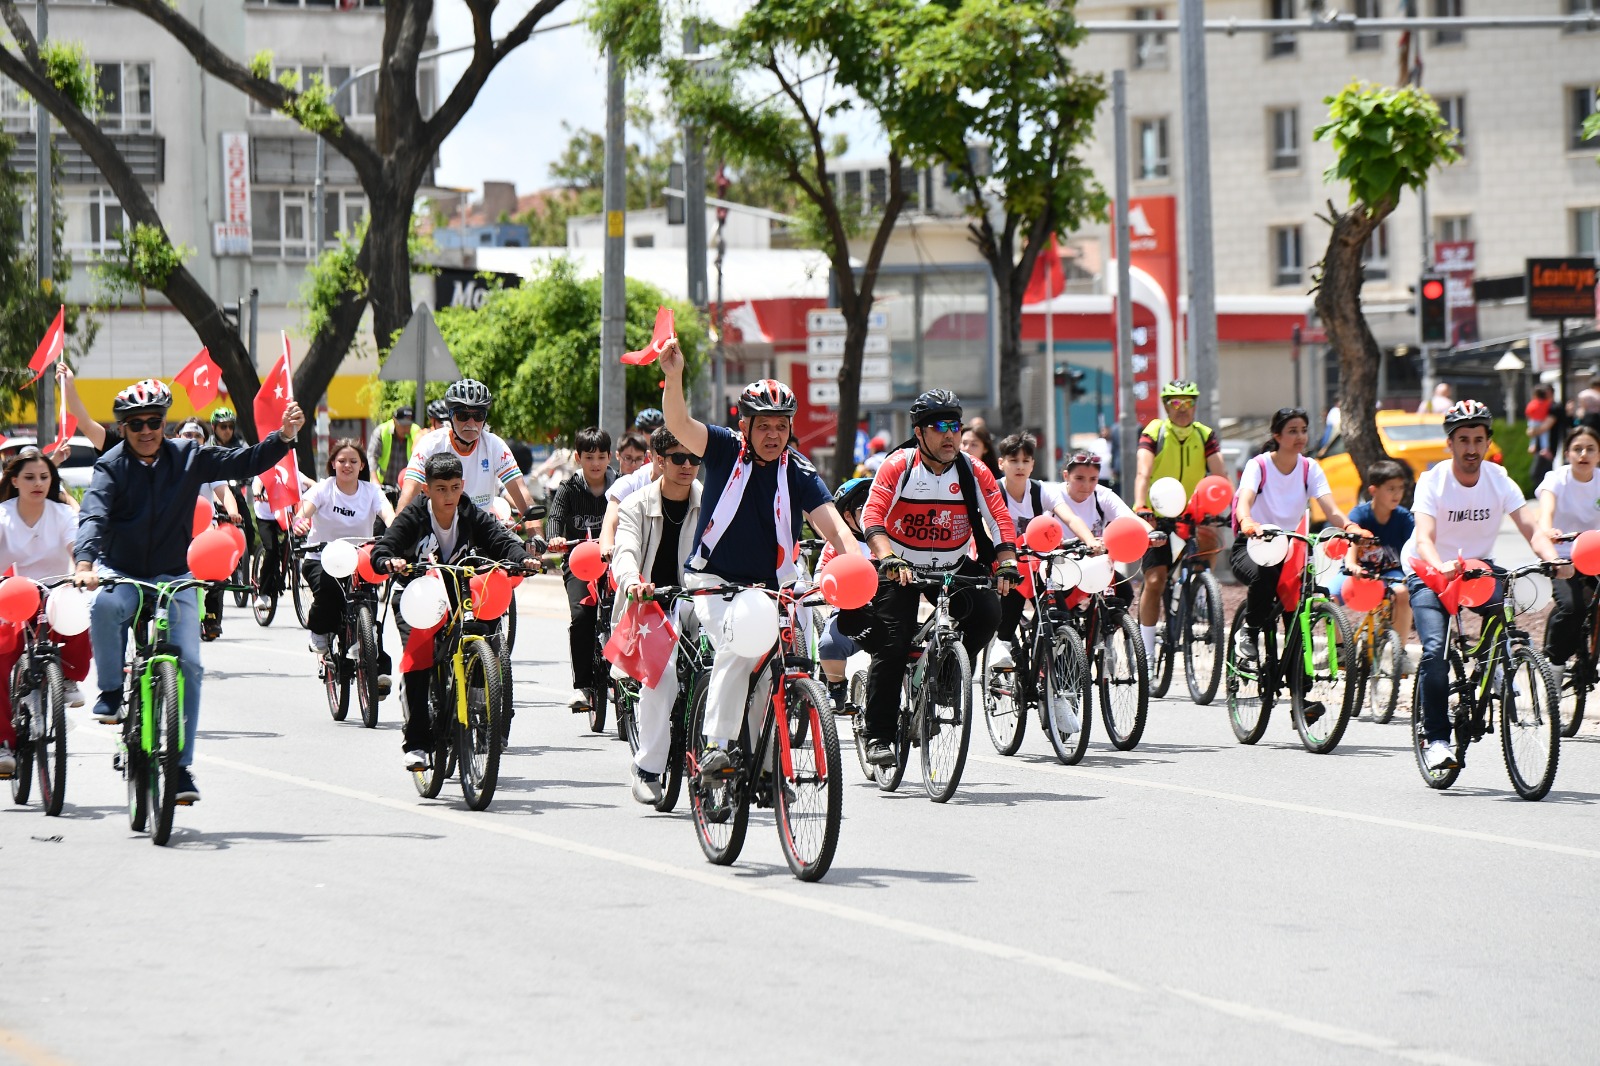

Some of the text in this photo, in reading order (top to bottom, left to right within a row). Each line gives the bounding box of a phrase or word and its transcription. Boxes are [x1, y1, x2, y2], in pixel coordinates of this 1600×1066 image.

[333, 505, 356, 517] miav
[1447, 508, 1490, 522] TIMELESS
[905, 526, 952, 541] DOSD
